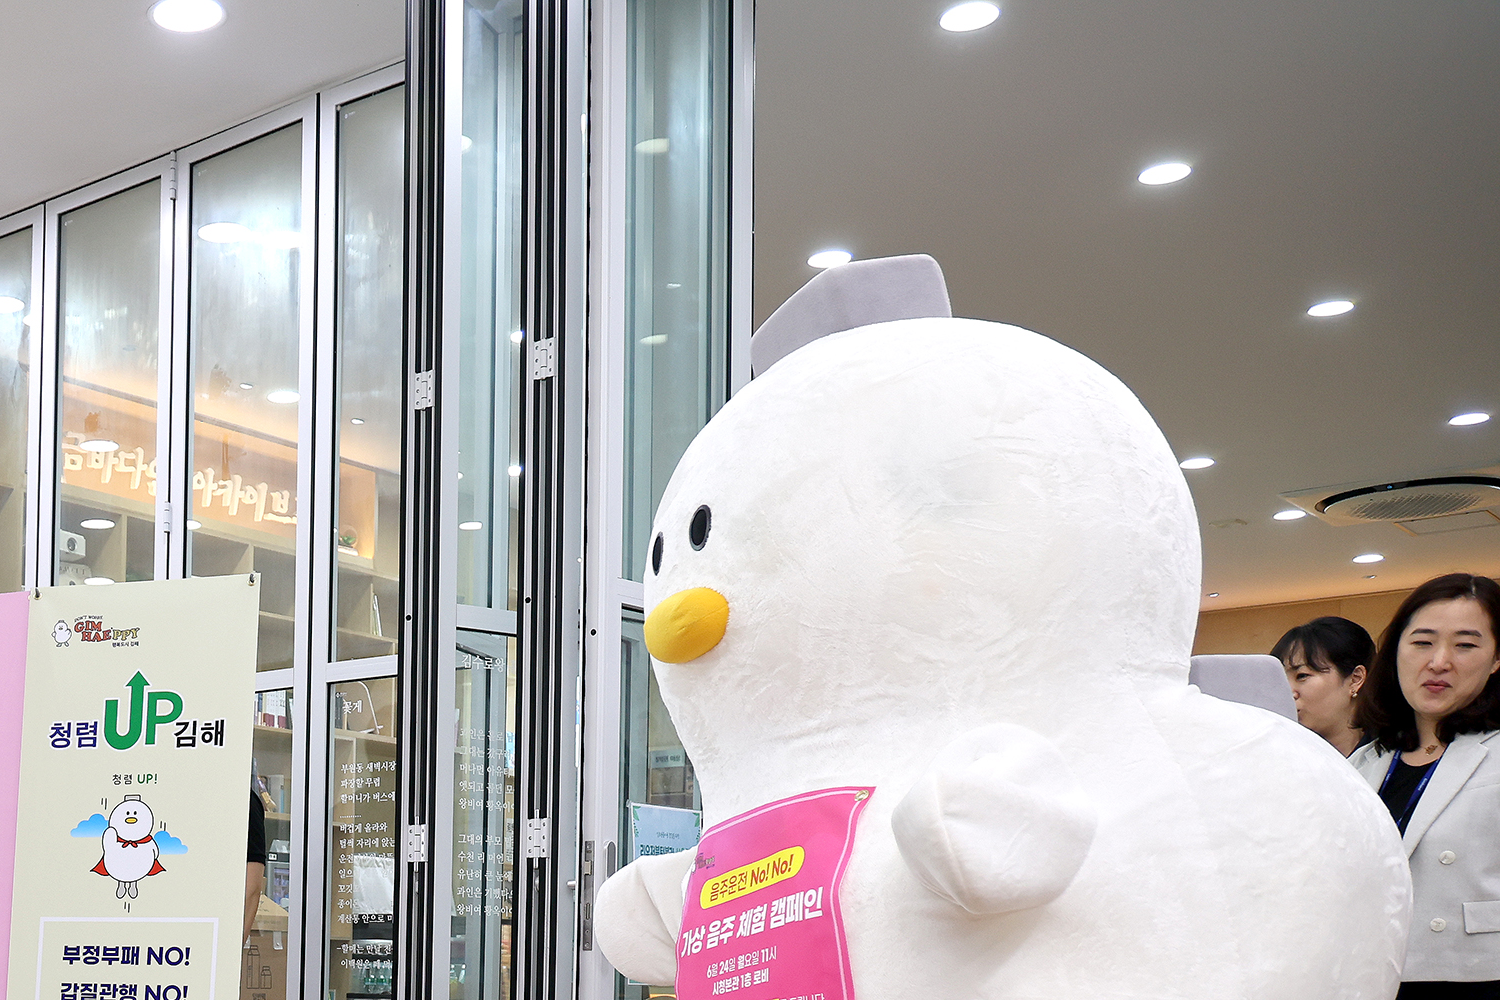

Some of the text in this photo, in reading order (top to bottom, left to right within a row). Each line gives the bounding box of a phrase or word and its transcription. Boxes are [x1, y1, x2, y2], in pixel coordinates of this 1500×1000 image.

[193, 468, 297, 524] 아카이브
[74, 620, 102, 633] GIM
[462, 654, 505, 672] 김수로왕
[50, 671, 225, 750] 청렴 UP 김해
[342, 699, 362, 715] 꽃게
[112, 773, 158, 786] 청렴 UP!
[710, 854, 794, 902] 음주운전 No! No!
[681, 886, 824, 958] 가상 음주 체험 캠페인
[62, 945, 191, 966] 부정부패 NO!
[707, 946, 777, 979] 6월 24일 월요일 11시
[712, 968, 770, 996] 시청본관 1층 로비
